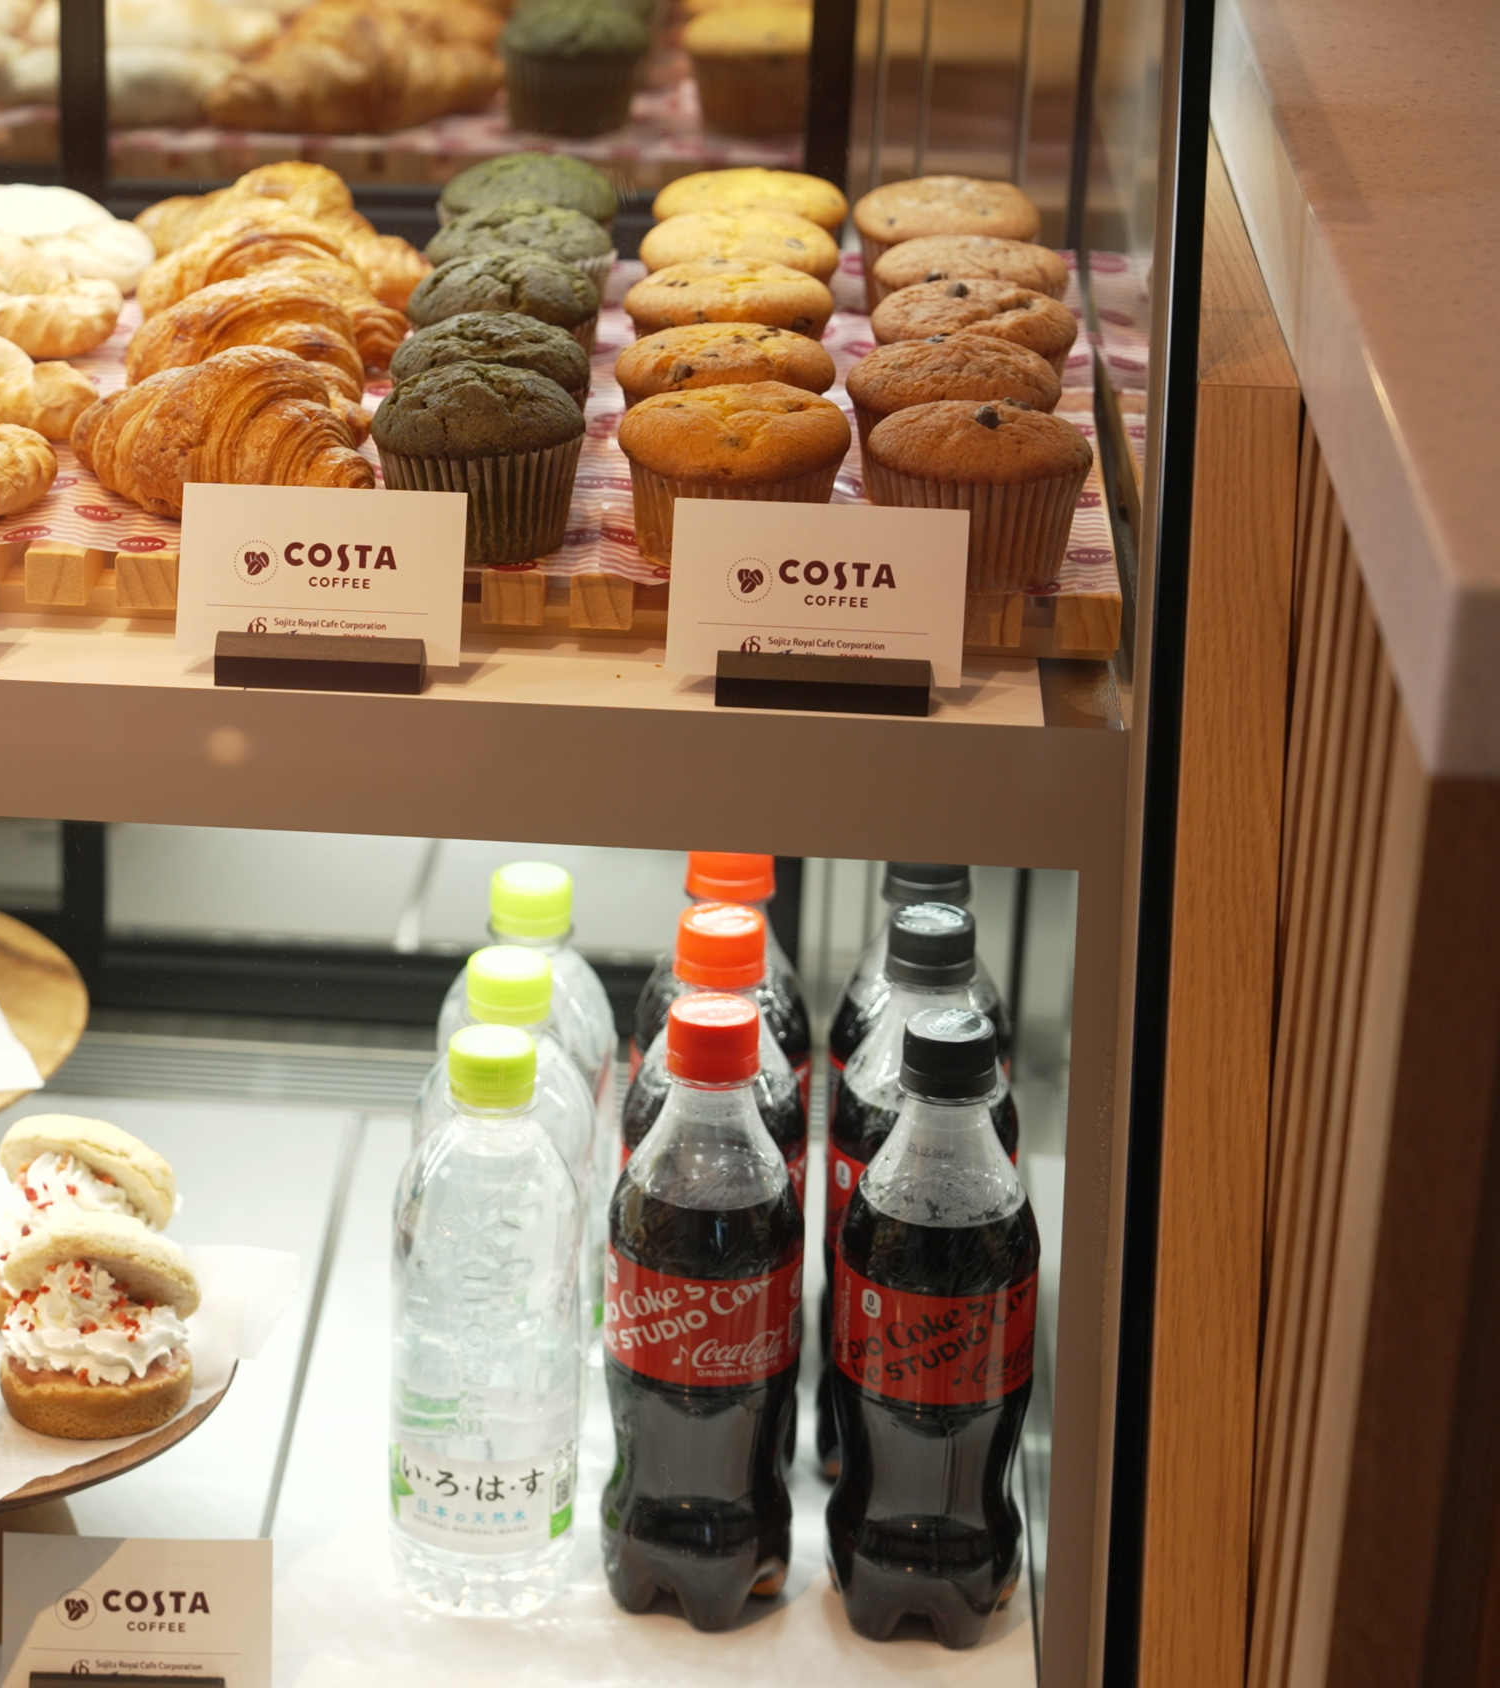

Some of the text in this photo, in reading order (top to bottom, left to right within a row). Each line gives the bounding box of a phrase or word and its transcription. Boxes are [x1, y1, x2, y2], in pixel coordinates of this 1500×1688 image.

[77, 506, 119, 518] COSTA
[7, 529, 48, 538] COSTA
[284, 542, 397, 572] COSTA
[308, 576, 371, 589] COFFEE
[778, 559, 896, 591] COSTA
[804, 595, 869, 608] COFFEE
[274, 618, 296, 628] Sojitz
[298, 618, 319, 629] Royal
[320, 619, 339, 628] Cafe
[340, 621, 386, 632] Corporation
[768, 636, 791, 647] Sojitz
[793, 638, 815, 648] Royal
[816, 639, 835, 648] Cafe
[836, 640, 885, 652] Corporation
[620, 1287, 682, 1319] Coke
[868, 1294, 874, 1306] 0
[619, 1310, 708, 1350] STUDIO
[886, 1308, 965, 1349] Coke
[885, 1326, 987, 1381] STUDIO
[696, 1359, 779, 1378] ORIGINAL TASTE
[417, 1498, 526, 1524] 日本の天然水
[452, 1526, 494, 1536] MINERAL
[498, 1525, 530, 1535] WATER
[102, 1590, 210, 1617] COSTA
[127, 1621, 186, 1633] COFFEE
[95, 1660, 117, 1669] Sojitz
[118, 1661, 139, 1670] Royal
[140, 1662, 157, 1671] Cafe
[158, 1662, 203, 1672] Corporation
